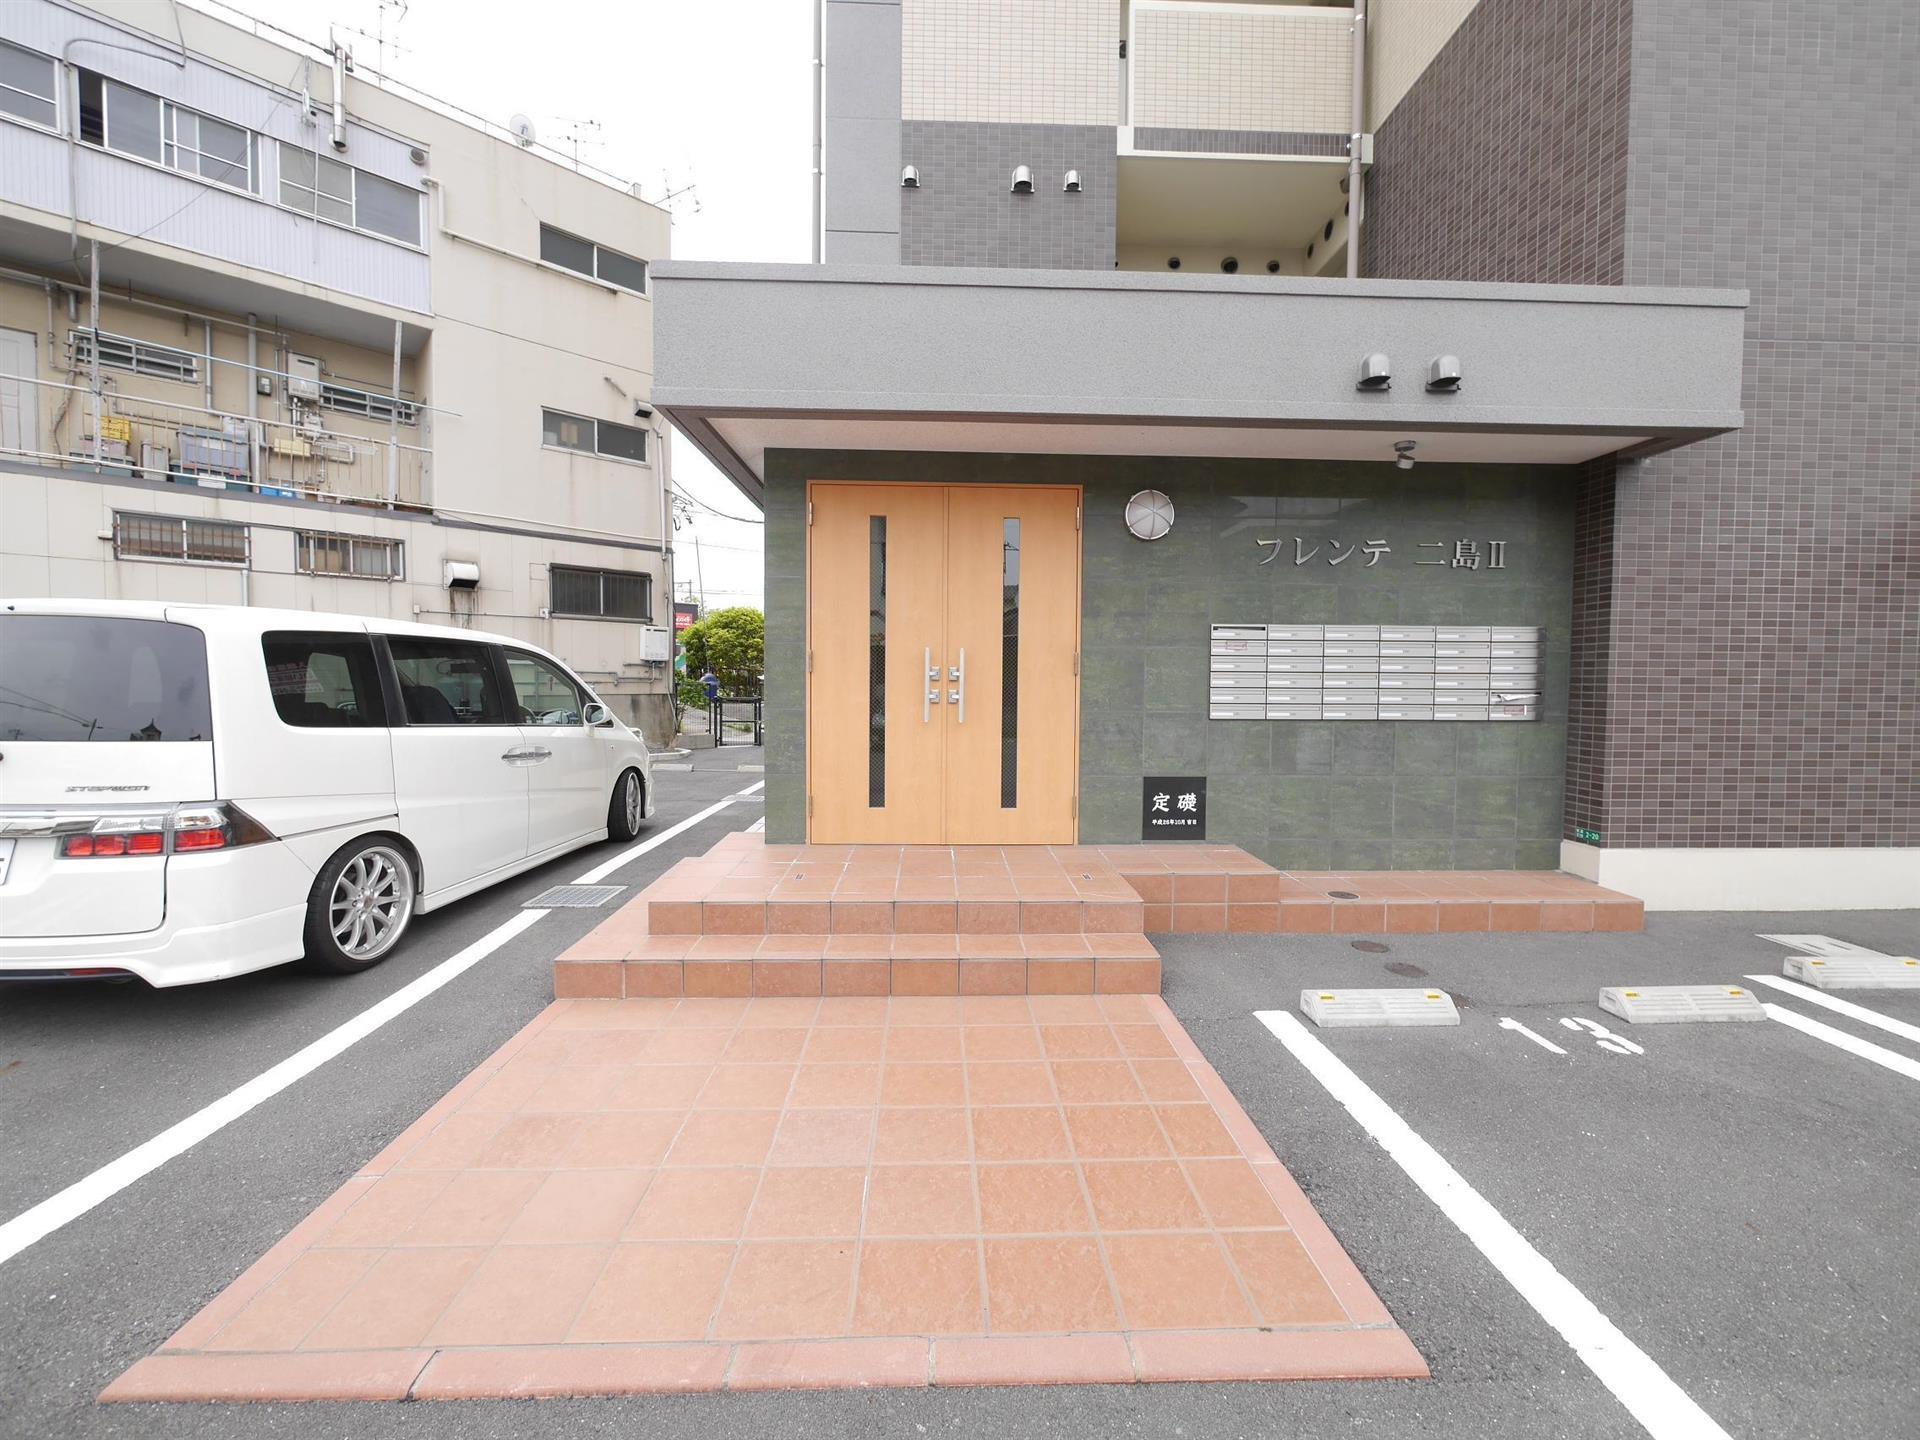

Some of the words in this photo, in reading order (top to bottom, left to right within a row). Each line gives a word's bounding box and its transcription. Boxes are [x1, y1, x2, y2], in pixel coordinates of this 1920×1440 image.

[1256, 537, 1392, 568] フレンテ
[1498, 1017, 1645, 1055] 13
